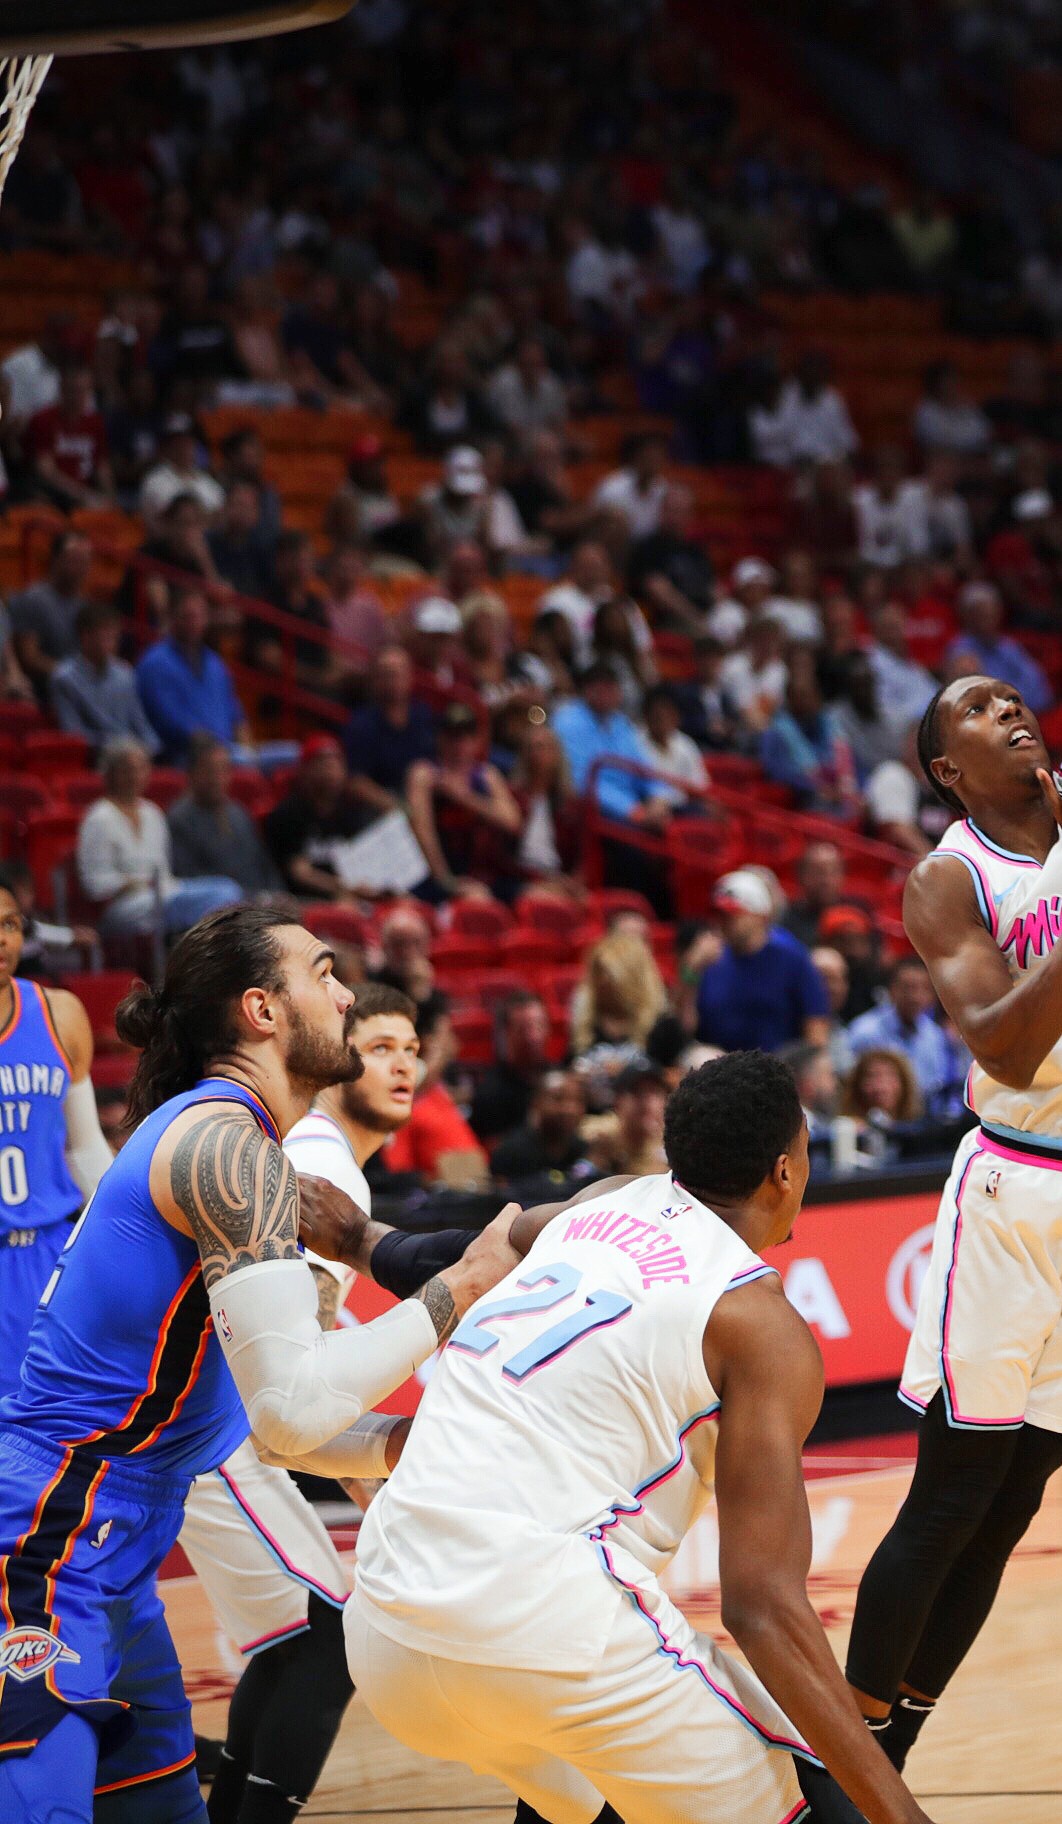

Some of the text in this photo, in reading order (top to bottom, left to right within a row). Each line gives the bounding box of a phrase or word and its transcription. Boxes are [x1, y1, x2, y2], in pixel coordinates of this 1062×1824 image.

[0, 1145, 29, 1206] 0
[562, 1210, 690, 1290] WHITESIDE
[446, 1261, 634, 1388] 21
